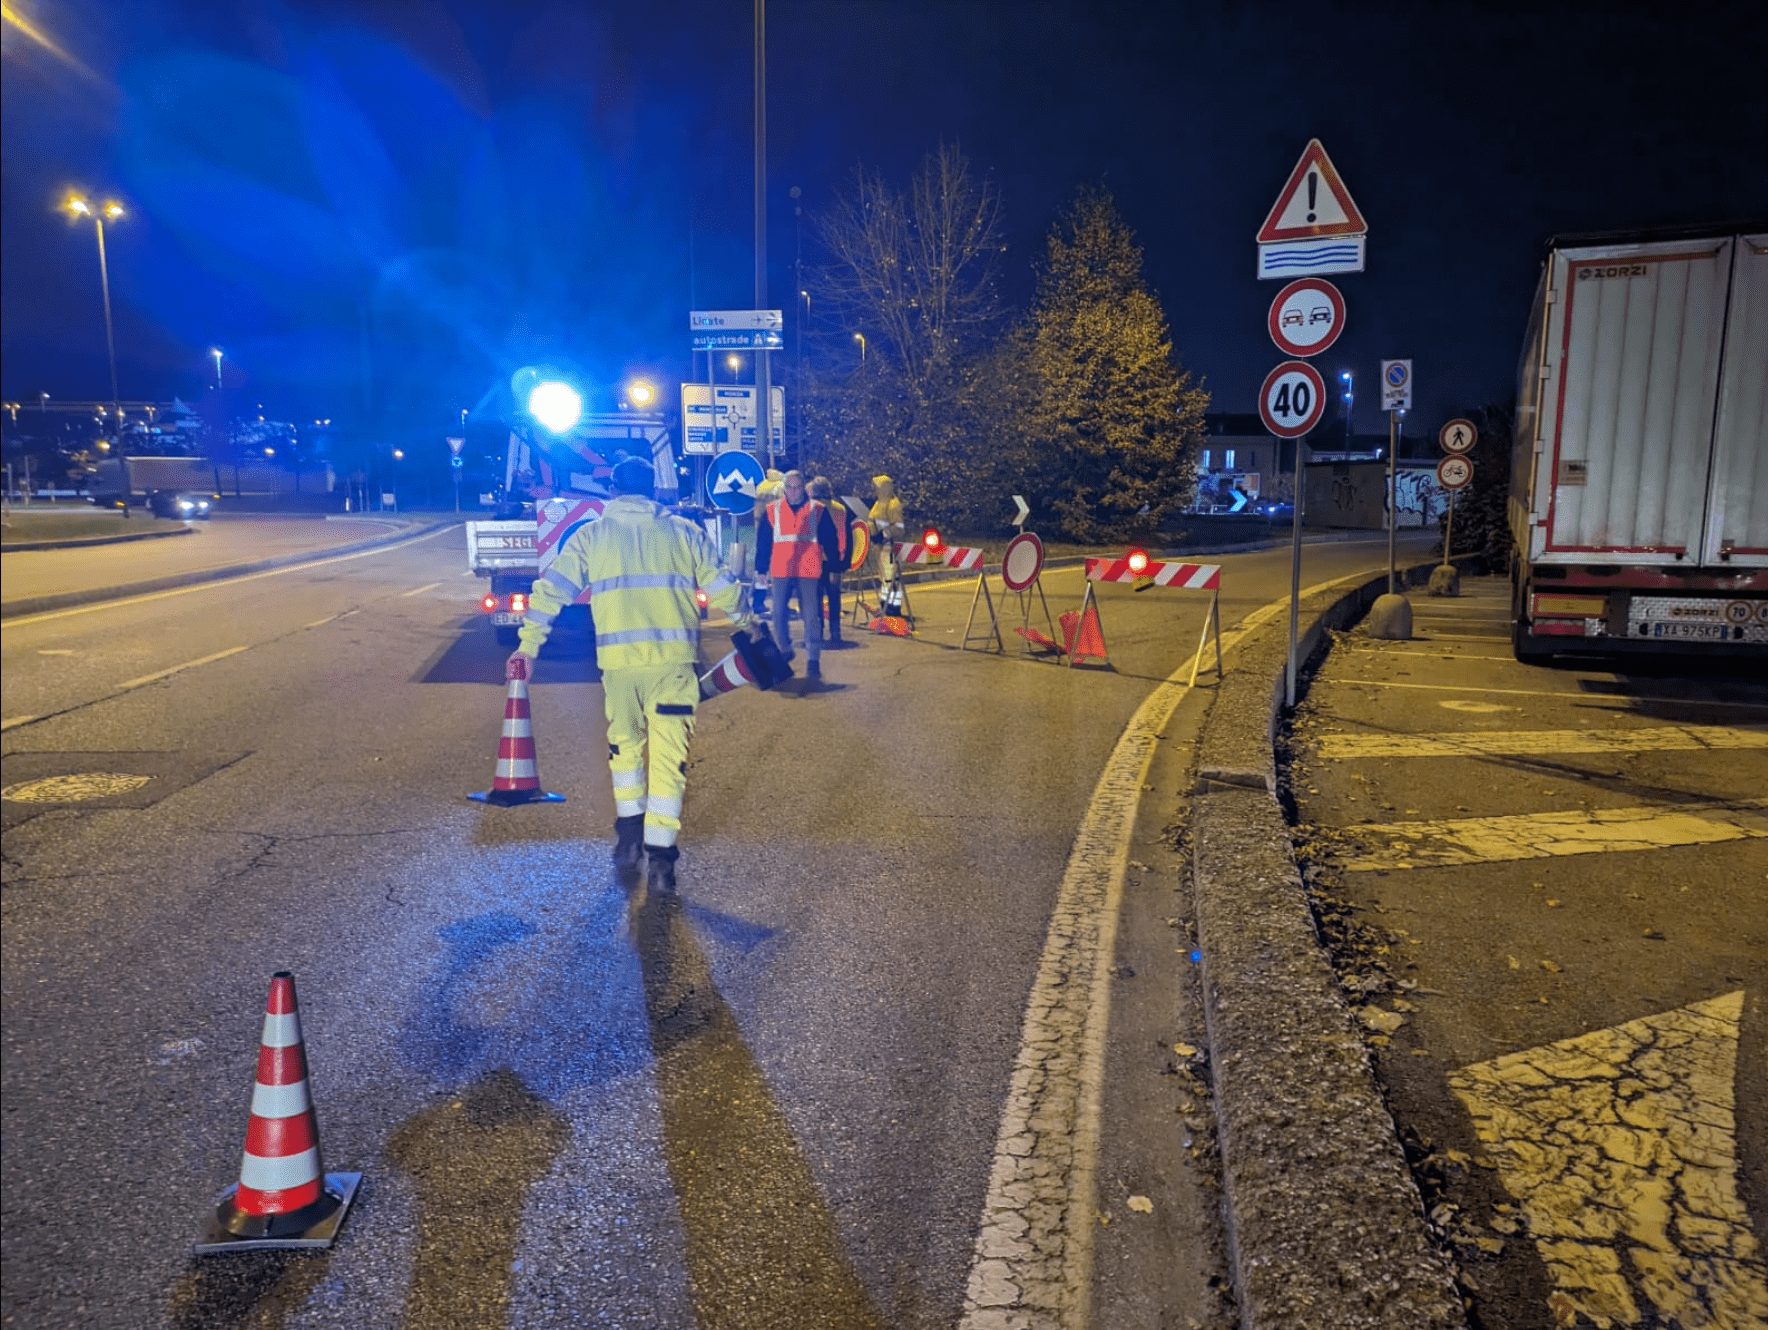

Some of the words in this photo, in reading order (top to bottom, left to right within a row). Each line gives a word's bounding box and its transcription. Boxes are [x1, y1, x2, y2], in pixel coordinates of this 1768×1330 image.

[1594, 265, 1647, 278] ZORZI
[693, 334, 749, 345] autostrade
[1273, 382, 1310, 417] 40
[1684, 608, 1719, 617] ZORZI
[1732, 607, 1744, 617] 70
